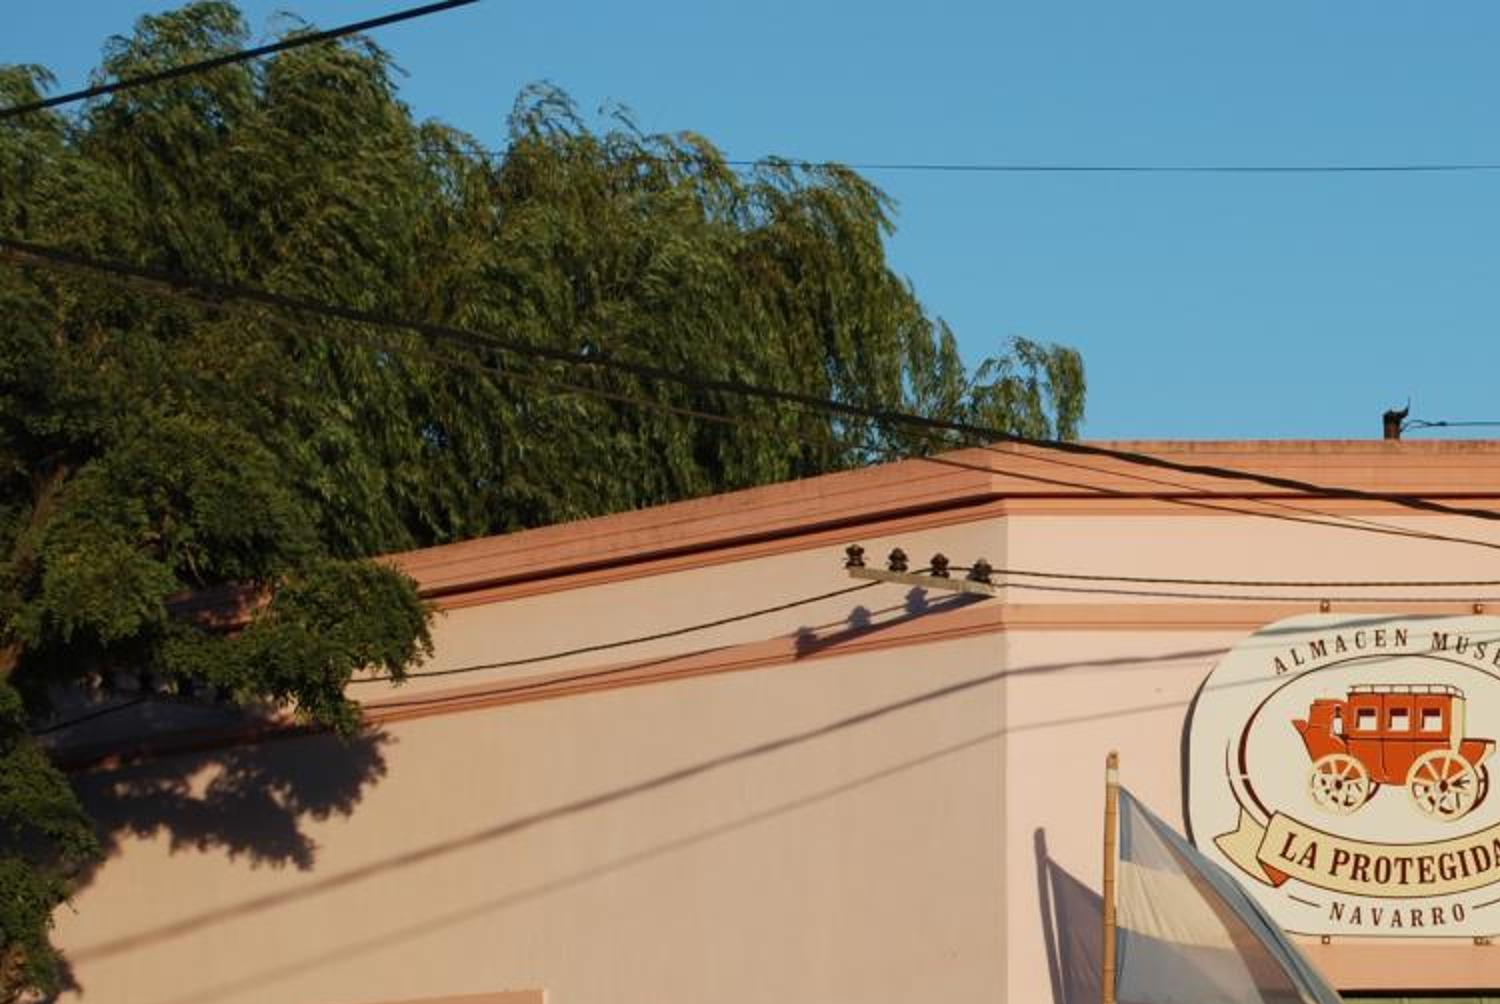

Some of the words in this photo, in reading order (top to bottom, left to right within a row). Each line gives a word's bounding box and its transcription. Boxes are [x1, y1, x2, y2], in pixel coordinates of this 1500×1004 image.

[1273, 628, 1409, 675] ALMACEN
[1279, 832, 1317, 869] LA
[1329, 901, 1467, 928] NAVARRO
